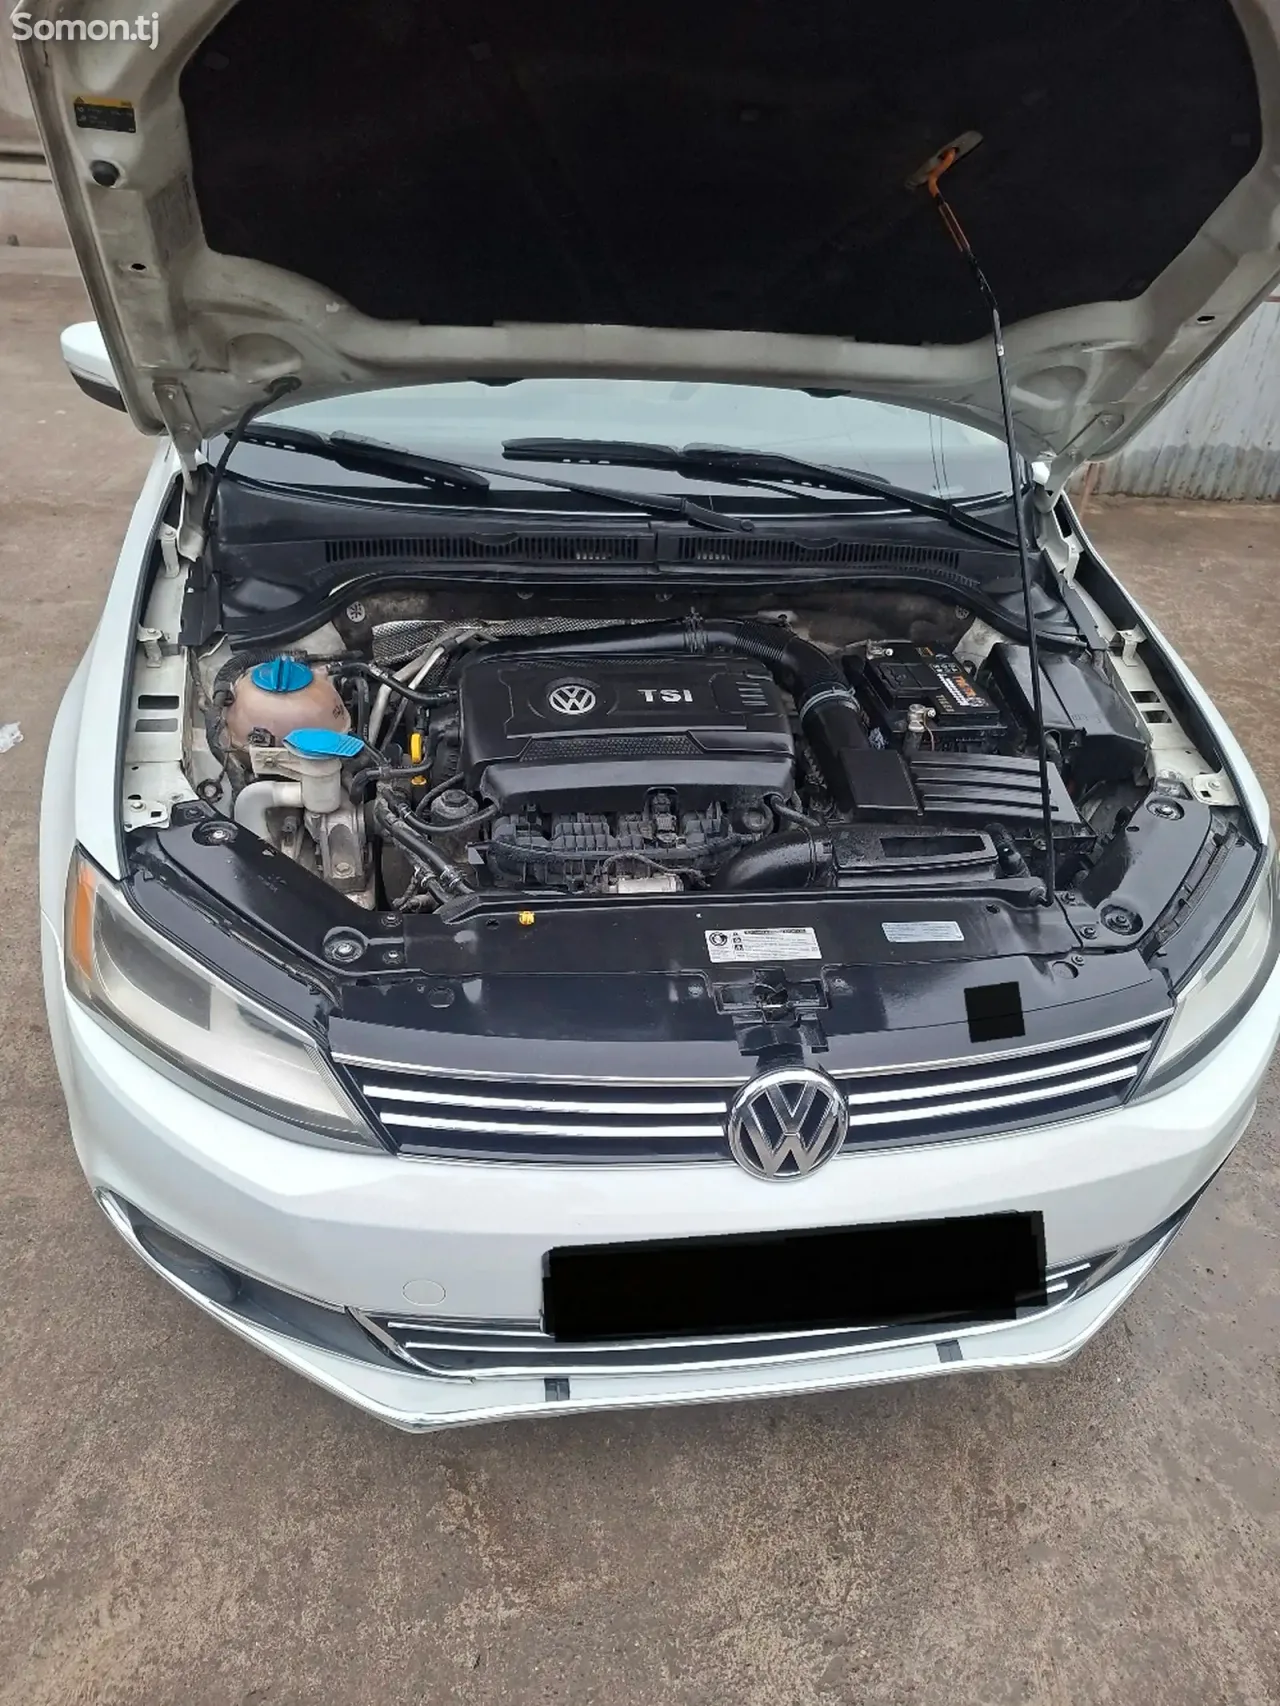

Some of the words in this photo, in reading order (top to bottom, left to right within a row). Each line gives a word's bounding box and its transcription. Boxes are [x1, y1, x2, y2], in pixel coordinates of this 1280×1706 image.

[551, 685, 595, 714] VW
[637, 688, 694, 703] TSI
[732, 1072, 844, 1180] VW
